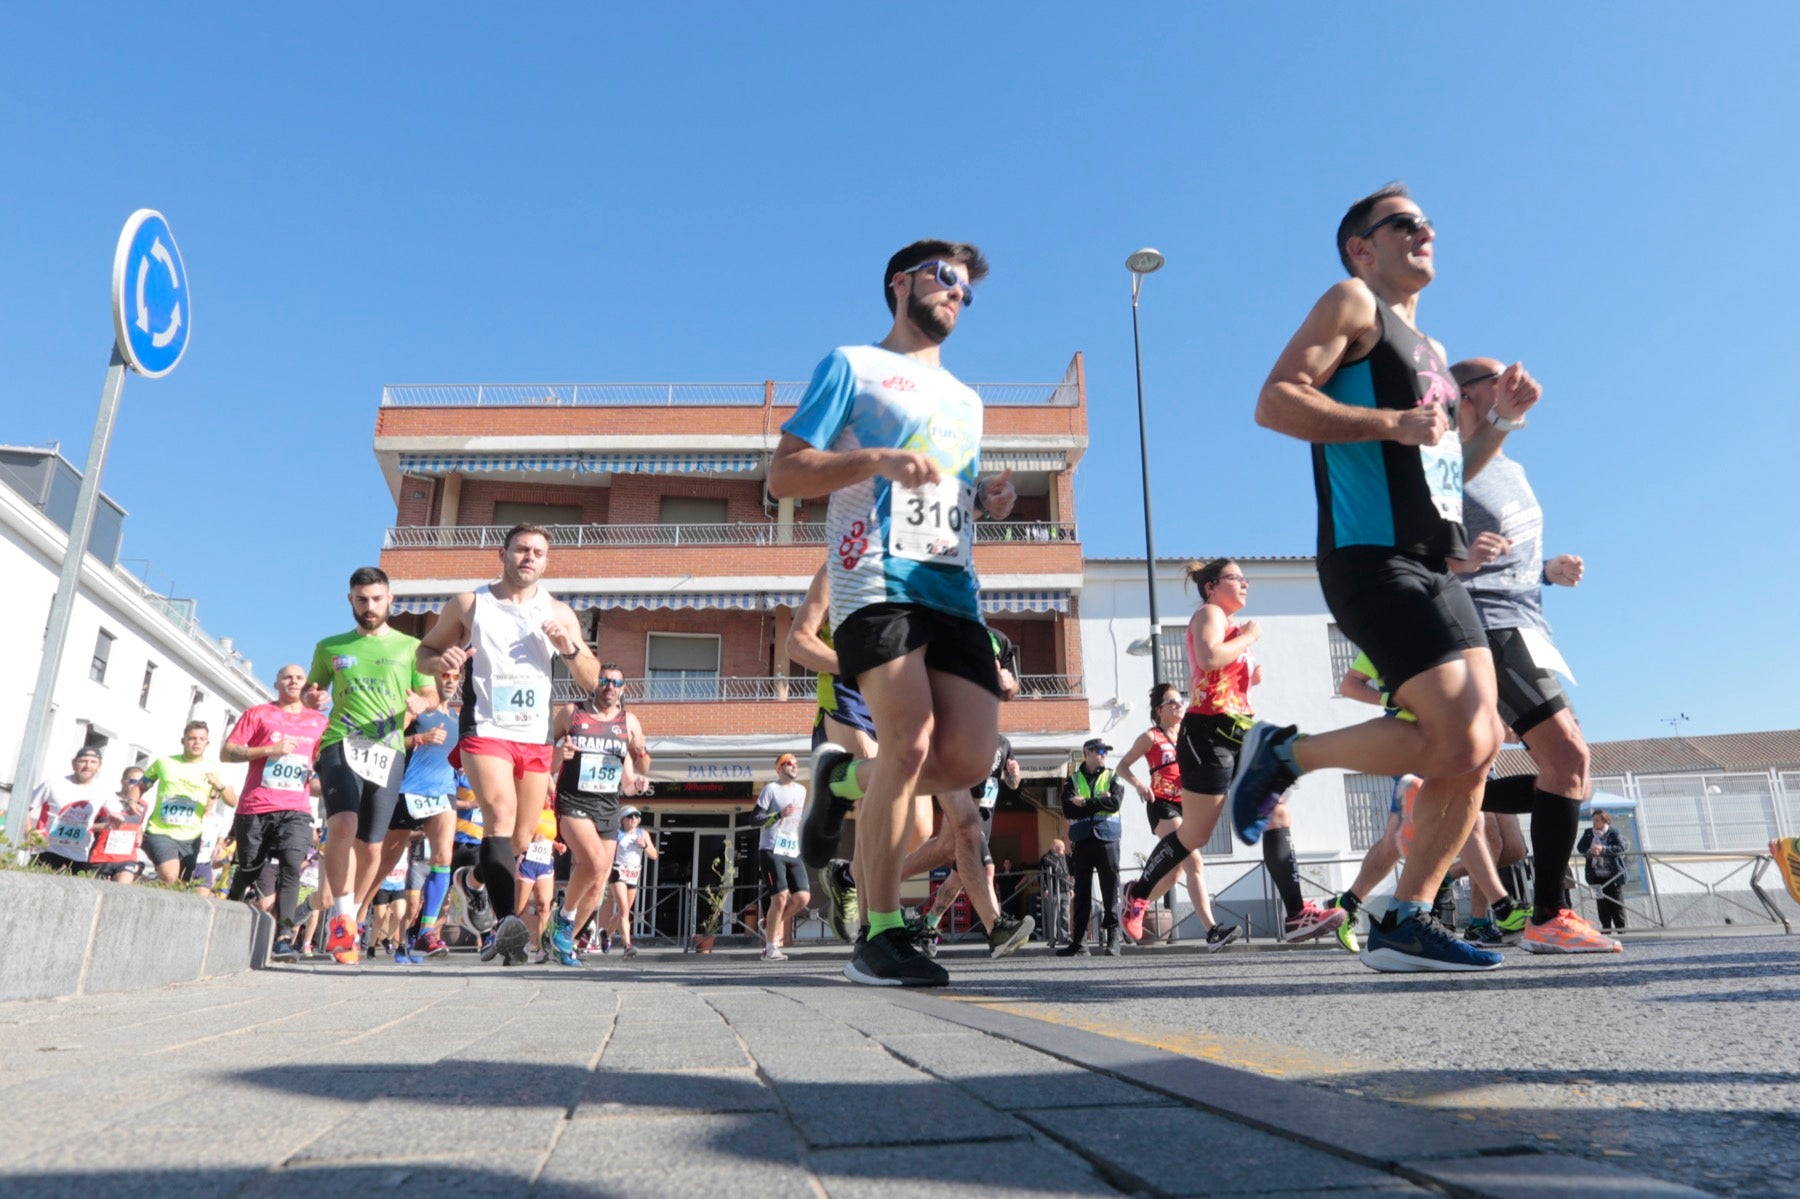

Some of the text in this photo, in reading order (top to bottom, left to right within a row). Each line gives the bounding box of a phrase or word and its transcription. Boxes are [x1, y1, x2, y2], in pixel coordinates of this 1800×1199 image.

[510, 689, 535, 708] 48
[350, 748, 389, 769] 3118
[272, 764, 303, 779] 809
[589, 766, 616, 781] 158
[687, 764, 753, 778] PARADA
[162, 804, 195, 817] 1070
[58, 827, 81, 839] 148
[780, 838, 797, 850] 815
